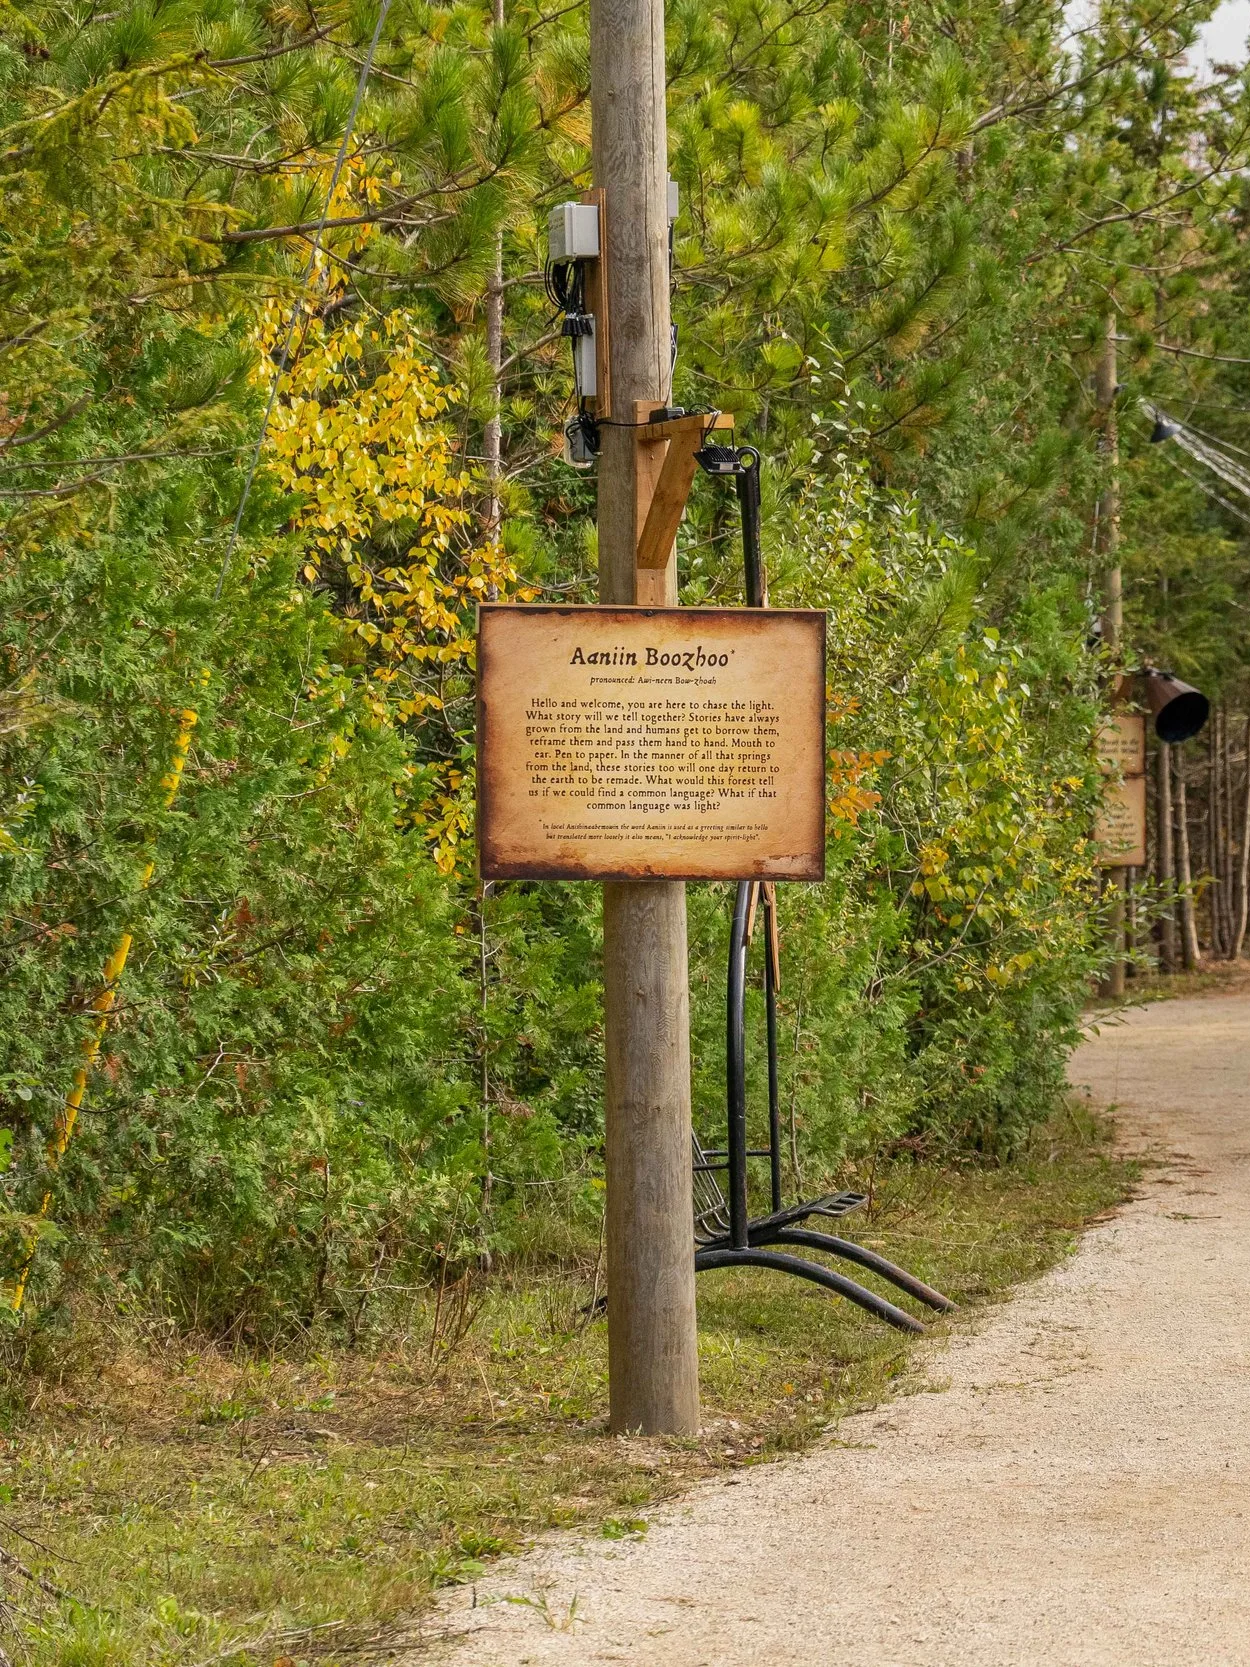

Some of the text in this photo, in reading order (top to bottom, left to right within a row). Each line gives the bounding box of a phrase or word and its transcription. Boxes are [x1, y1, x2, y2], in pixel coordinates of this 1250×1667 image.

[570, 646, 638, 666] Aaniin
[590, 675, 635, 686] pronounced:
[531, 698, 558, 708] Hello
[560, 698, 578, 708] and
[580, 698, 625, 710] welcome,
[627, 701, 646, 712] you
[665, 699, 687, 709] here
[689, 701, 700, 709] to
[702, 699, 728, 709] chase
[731, 699, 746, 709] the
[749, 699, 775, 713] light.
[526, 710, 553, 720] What
[556, 712, 582, 724] story
[584, 710, 603, 721] will
[622, 711, 638, 721] tell
[641, 711, 686, 725] together?
[688, 711, 722, 722] Stories
[724, 712, 746, 722] have
[748, 712, 780, 726] always
[525, 723, 780, 738] grown from the land and humans get to borrow them,
[529, 735, 776, 750] reframe them and pass them hand to hand. Mouth to
[554, 748, 573, 758] Pen
[575, 750, 586, 758] to
[588, 751, 618, 762] paper.
[620, 748, 630, 759] In
[633, 748, 649, 759] the
[688, 749, 700, 759] of
[701, 749, 713, 759] all
[715, 749, 735, 759] that
[737, 749, 771, 763] springs
[525, 760, 549, 771] from
[551, 760, 568, 771] the
[569, 761, 593, 773] land,
[595, 761, 621, 771] these
[623, 761, 656, 771] stories
[658, 763, 675, 772] too
[677, 761, 696, 772] will
[718, 762, 736, 776] day
[737, 764, 767, 772] return
[769, 764, 780, 772] to
[531, 773, 775, 785] the earth to be remade. What would this forest tell
[542, 786, 551, 796] if
[569, 786, 595, 796] could
[597, 786, 617, 796] find
[627, 789, 667, 797] common
[670, 787, 715, 801] language?
[718, 787, 745, 797] What
[747, 787, 756, 798] if
[758, 787, 777, 798] that
[629, 799, 671, 813] language
